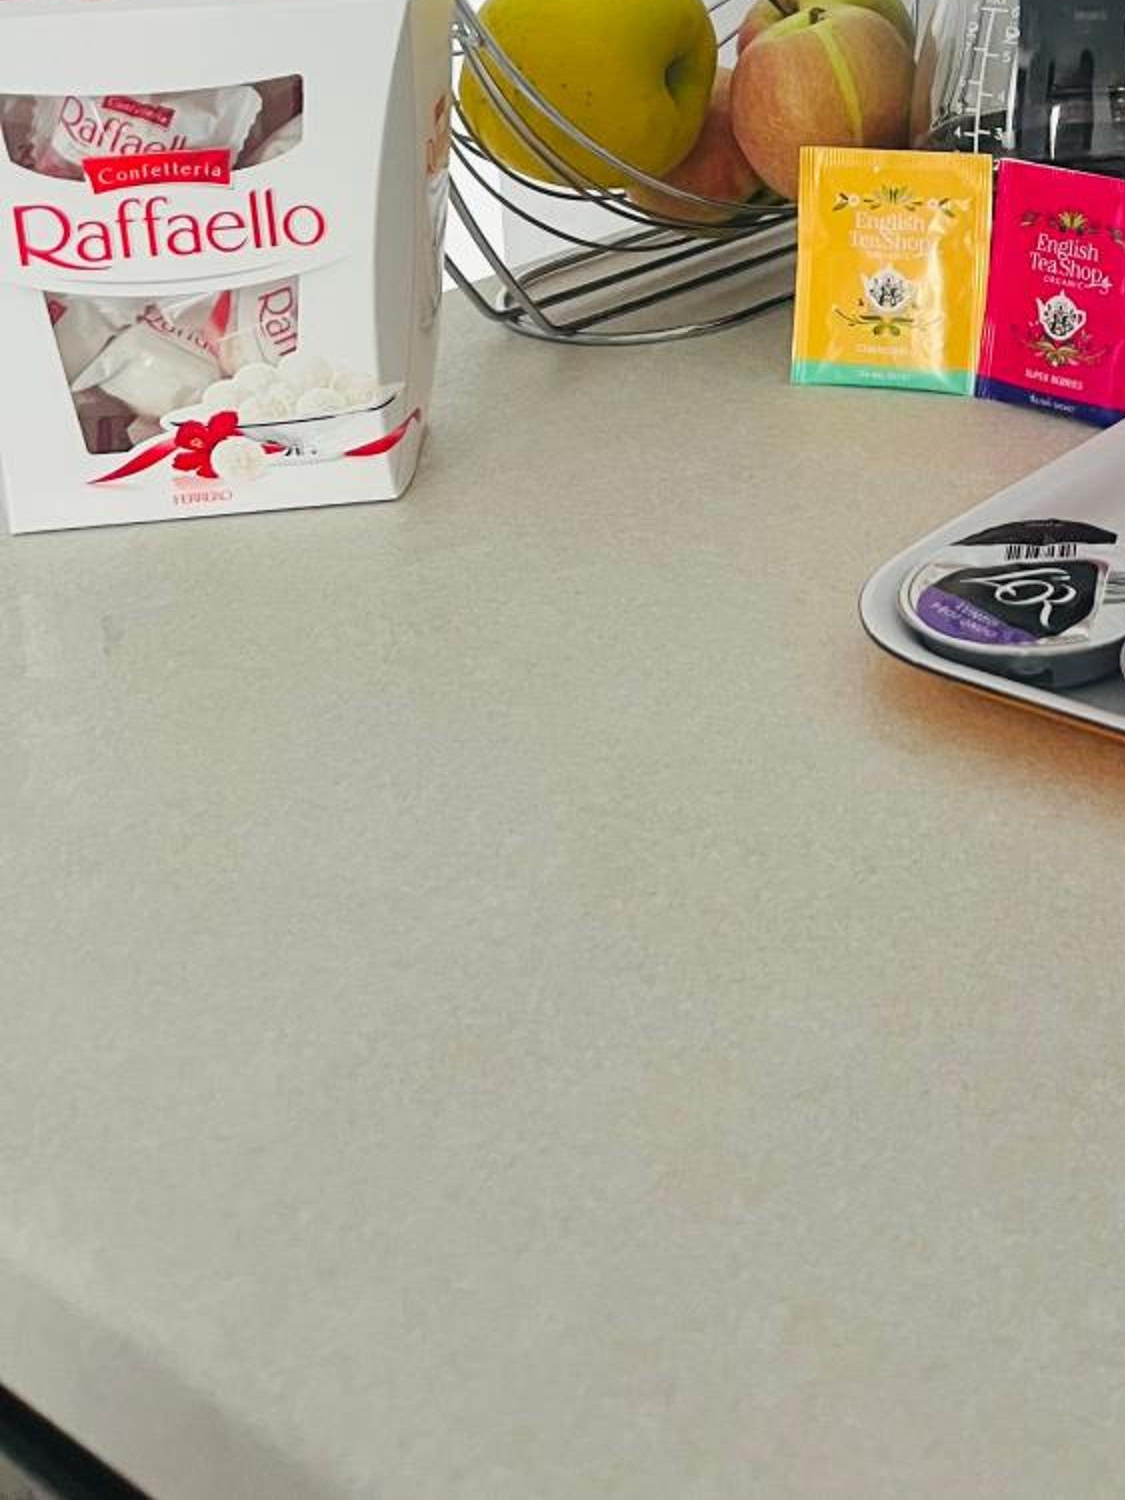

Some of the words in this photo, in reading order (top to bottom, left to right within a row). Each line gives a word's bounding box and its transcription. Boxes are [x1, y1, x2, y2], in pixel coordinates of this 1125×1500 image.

[97, 158, 223, 186] Confetteria
[13, 188, 327, 272] Raffaello
[1036, 233, 1099, 262] English
[1030, 251, 1057, 274] Tea
[1059, 258, 1107, 288] Shop
